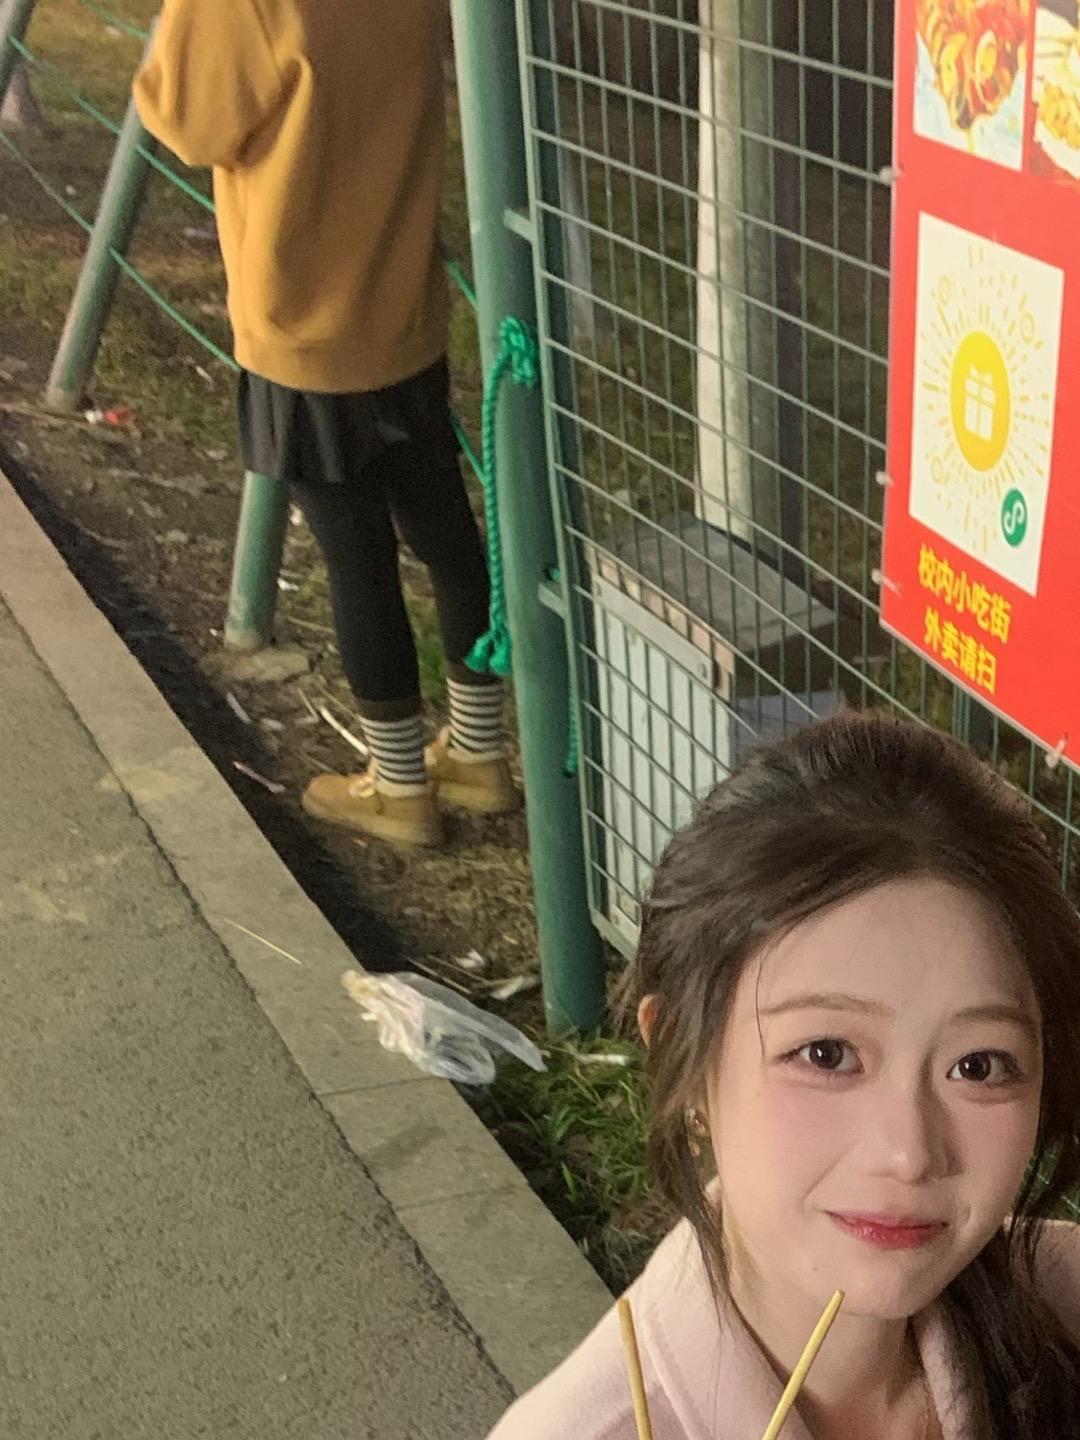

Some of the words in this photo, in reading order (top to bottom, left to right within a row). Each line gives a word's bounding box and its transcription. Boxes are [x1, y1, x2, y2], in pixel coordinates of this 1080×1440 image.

[917, 543, 1012, 644] 校内小吃街
[924, 605, 998, 695] 外卖请扫
